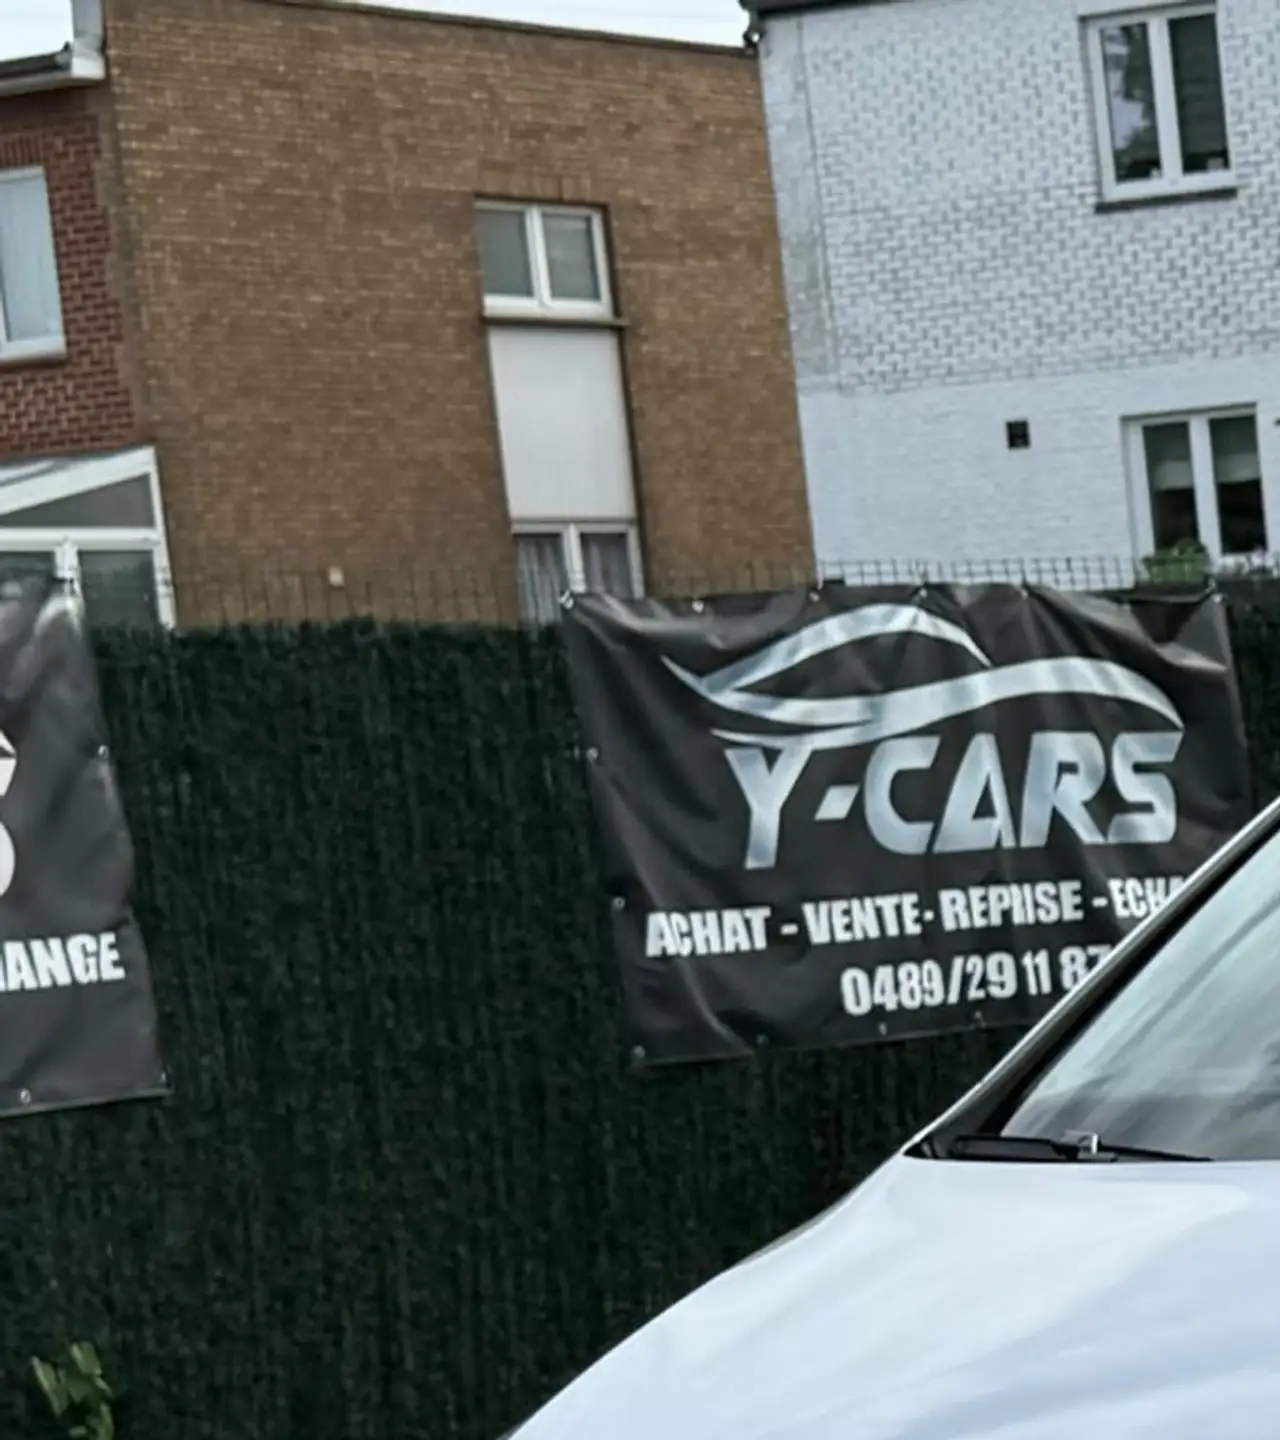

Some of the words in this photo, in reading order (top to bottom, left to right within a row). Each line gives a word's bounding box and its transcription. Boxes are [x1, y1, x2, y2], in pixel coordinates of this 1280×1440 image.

[724, 731, 1183, 870] Y-CARS
[646, 906, 771, 957] ACHAT
[802, 892, 922, 945] VENTE
[0, 931, 126, 992] ANGE
[841, 951, 1018, 1016] 0489/29
